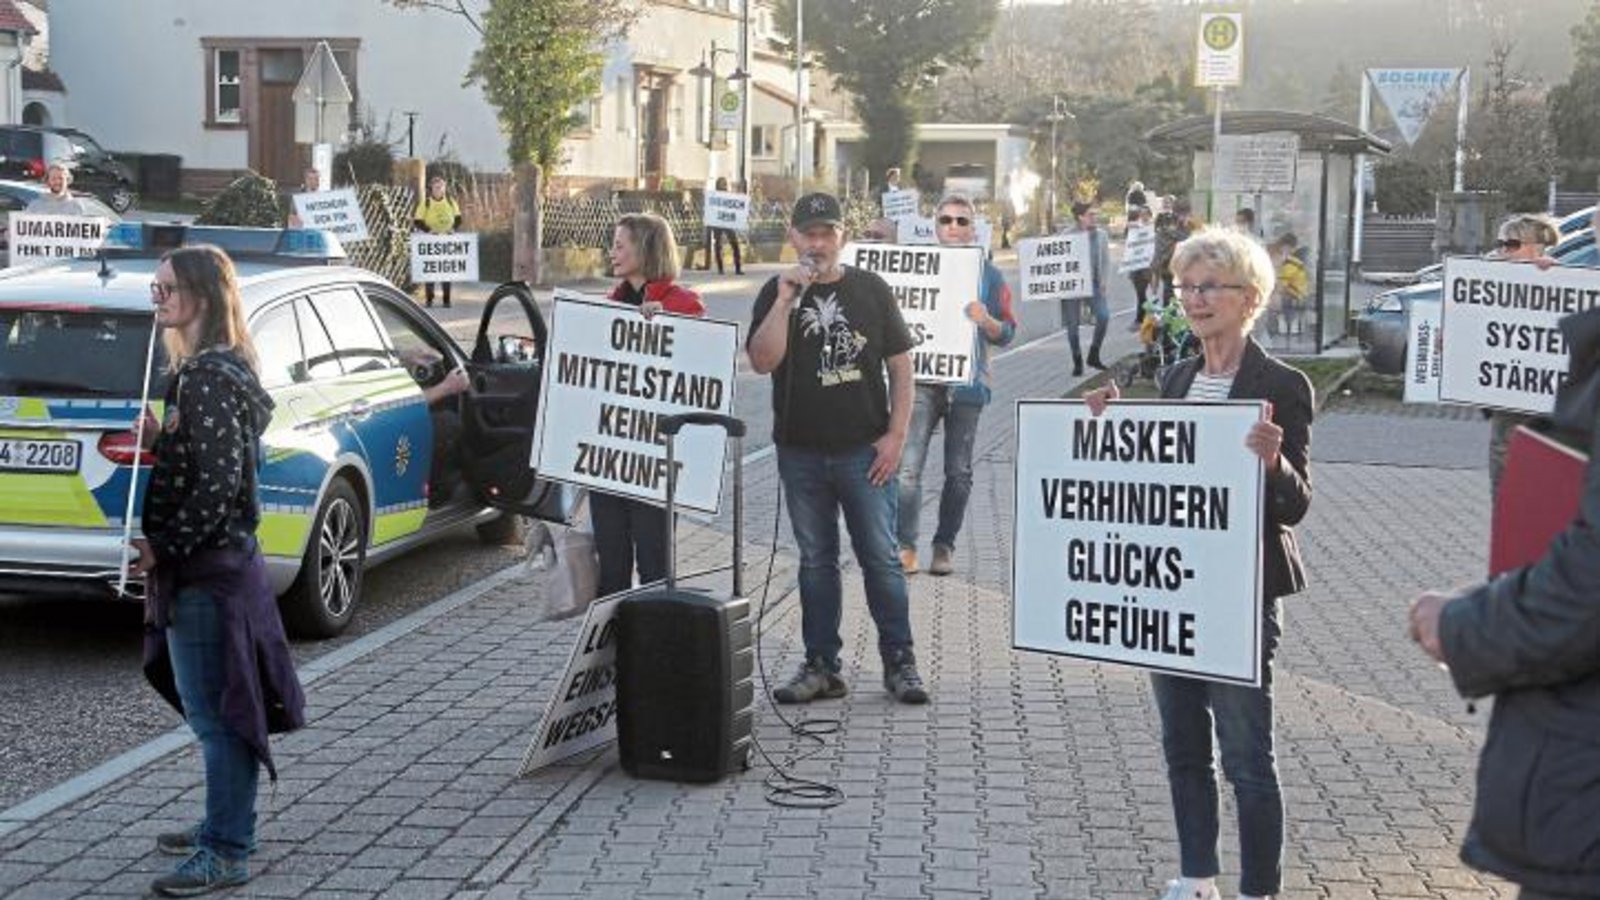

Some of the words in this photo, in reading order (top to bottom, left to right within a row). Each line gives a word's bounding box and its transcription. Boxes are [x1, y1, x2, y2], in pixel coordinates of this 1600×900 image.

[17, 221, 100, 239] UMARMEN
[17, 244, 51, 256] FEHLT
[418, 241, 469, 255] GESICHT
[855, 249, 940, 275] FRIEDEN
[1037, 241, 1072, 257] ANGST
[423, 260, 466, 273] ZEIGEN
[889, 286, 940, 311] HEIT
[611, 318, 675, 358] OHNE
[558, 352, 723, 410] MITTELSTAND
[598, 403, 668, 446] KEINE
[1072, 419, 1196, 464] MASKEN
[26, 443, 74, 466] 2208
[1041, 478, 1229, 531] VERHINDERN
[1067, 532, 1195, 591] GLÜCKS-
[584, 617, 619, 655] LO
[1065, 595, 1196, 657] GEFÜHLE
[565, 668, 618, 702] EINS
